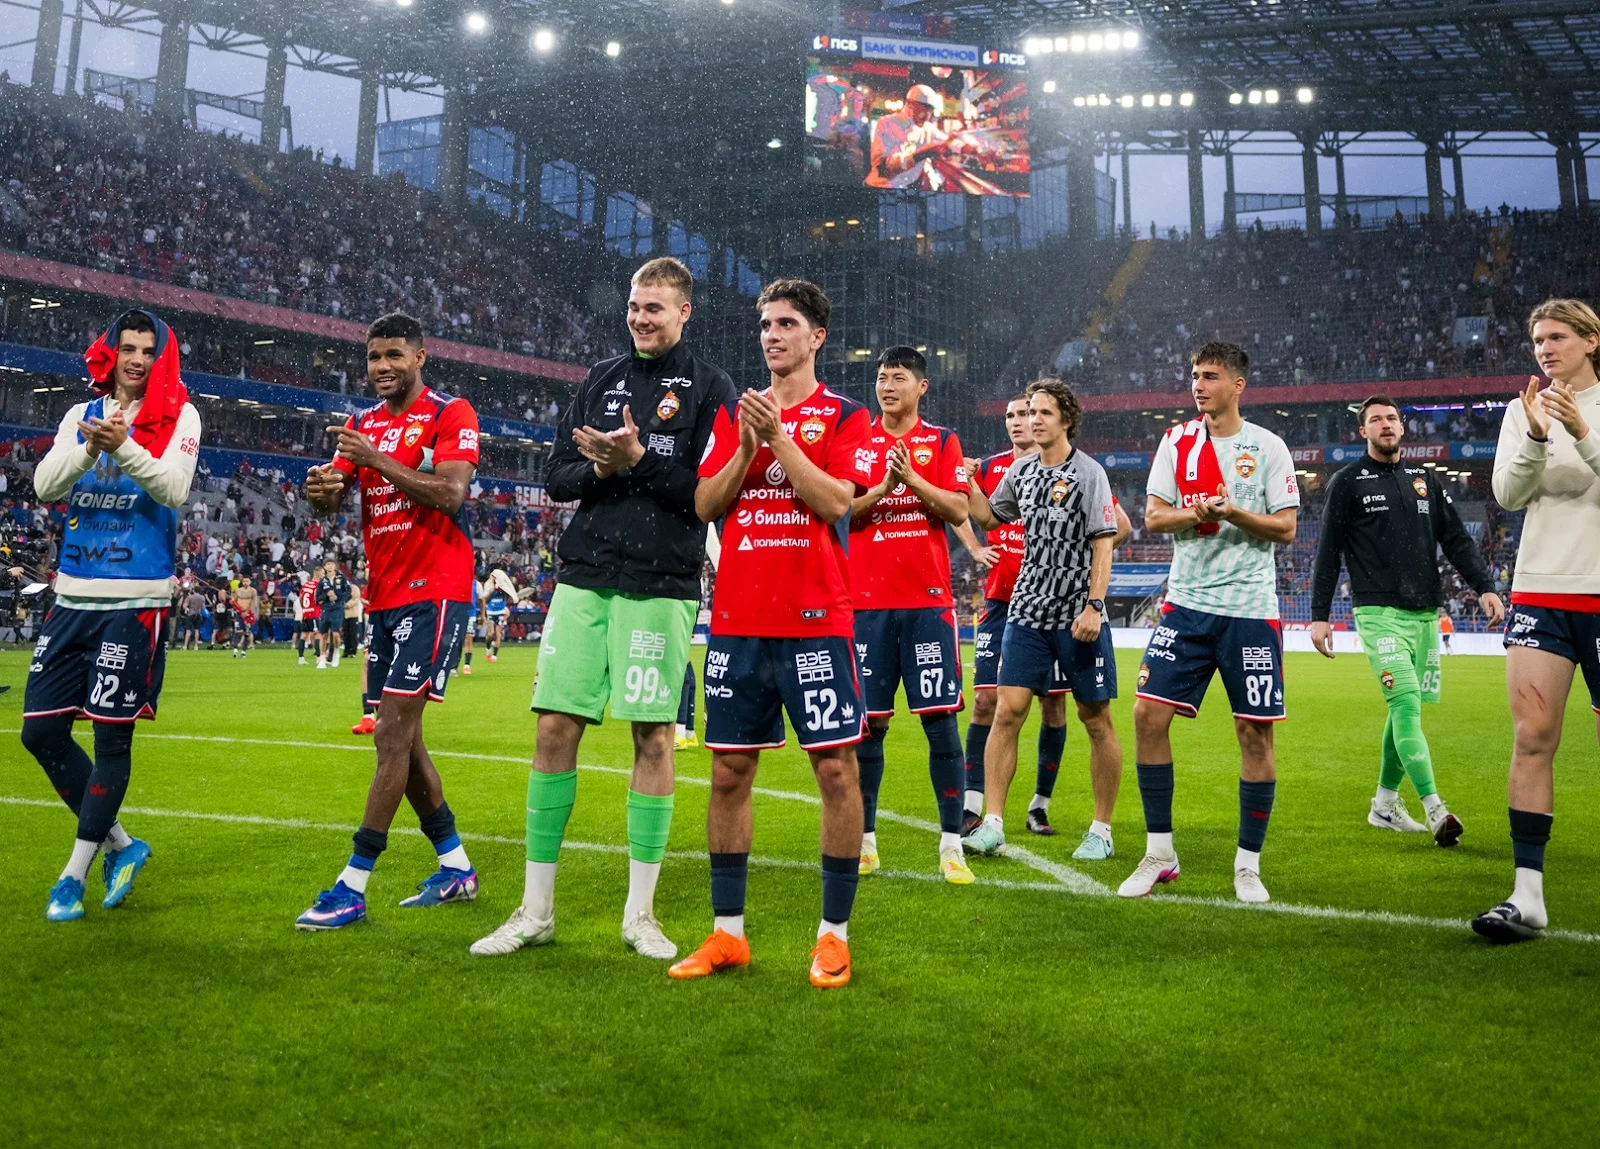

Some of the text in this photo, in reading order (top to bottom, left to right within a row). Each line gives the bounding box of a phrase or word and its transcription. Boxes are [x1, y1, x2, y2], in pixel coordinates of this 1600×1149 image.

[831, 37, 858, 51] ПСБ
[864, 41, 977, 62] БАНК ЧЕМПИОНОВ
[999, 53, 1026, 65] ПСБ
[71, 492, 138, 510] FONBET
[755, 509, 810, 526] билайн
[885, 530, 928, 539] ПОЛИМЕТАЛЛ
[754, 538, 809, 549] ПОЛИМЕТАЛЛ
[1514, 612, 1539, 626] FON
[631, 629, 666, 646] ВЭБ
[1155, 626, 1178, 639] FON
[101, 641, 129, 656] ВЭБ
[915, 641, 941, 654] ВЭБ
[1151, 634, 1175, 648] BET
[1377, 636, 1396, 646] FON
[1242, 646, 1272, 658] ВЭБ
[1378, 645, 1396, 654] BET
[707, 650, 730, 666] FON
[795, 650, 832, 668] ВЭБ
[706, 663, 729, 680] BET
[91, 672, 120, 708] 62
[624, 664, 659, 704] 99
[920, 667, 944, 698] 67
[1421, 670, 1441, 694] 85
[1246, 675, 1273, 706] 87
[804, 688, 840, 732] 52
